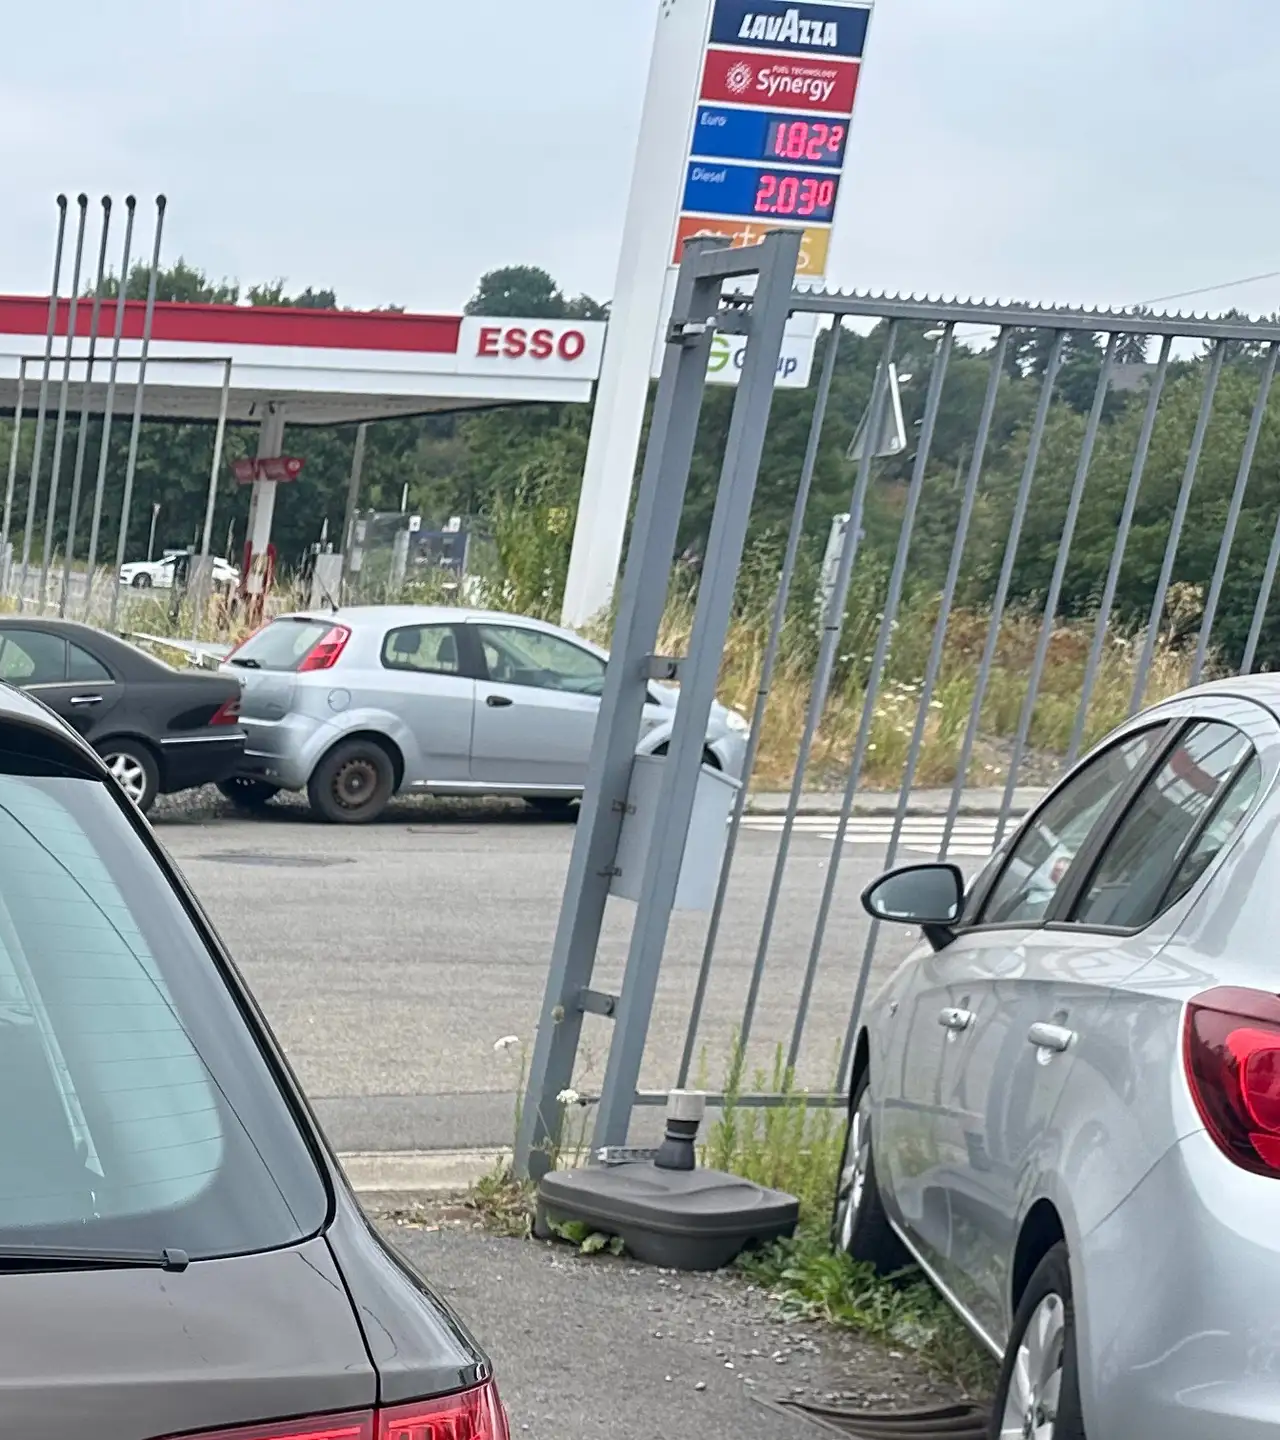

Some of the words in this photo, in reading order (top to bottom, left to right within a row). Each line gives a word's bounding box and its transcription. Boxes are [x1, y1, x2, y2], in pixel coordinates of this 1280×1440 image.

[738, 8, 838, 48] LAVAZZA
[756, 68, 836, 102] Synergy
[700, 111, 727, 127] Euro
[691, 167, 727, 183] Diesel
[476, 327, 586, 361] ESSO
